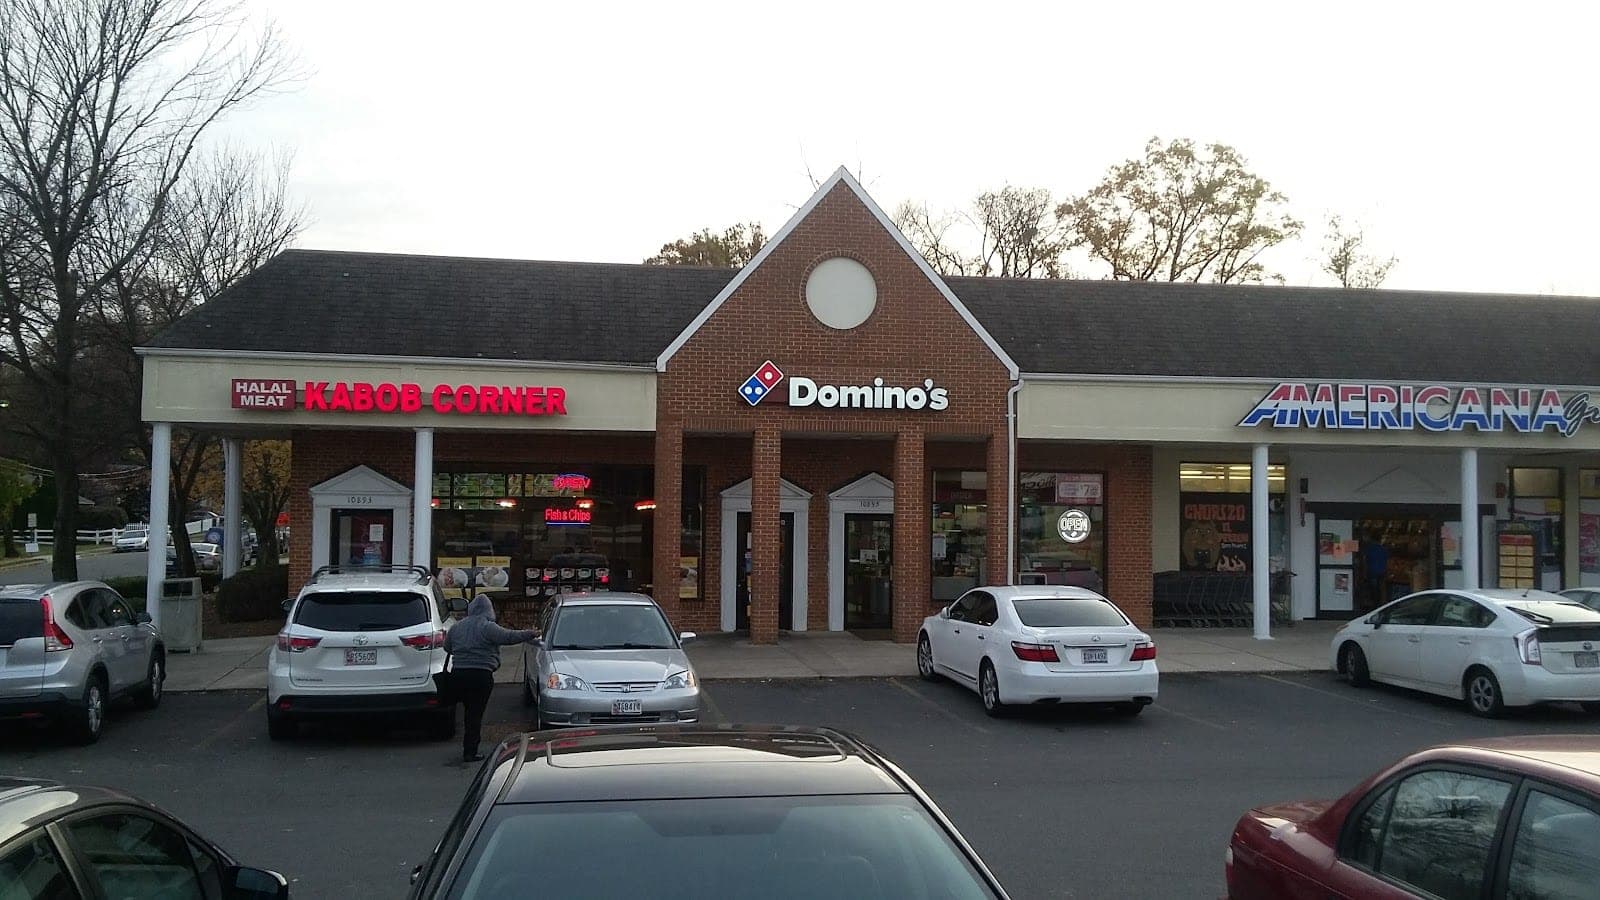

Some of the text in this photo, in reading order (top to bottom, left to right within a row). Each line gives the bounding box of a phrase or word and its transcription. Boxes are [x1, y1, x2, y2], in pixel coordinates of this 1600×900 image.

[235, 382, 292, 394] HALAL
[788, 376, 950, 411] Domino's
[239, 394, 288, 407] MEAT
[304, 380, 568, 416] KABOB CORNER
[1238, 383, 1568, 432] AMERICANA
[544, 508, 562, 521] Fish
[568, 508, 592, 523] Chips
[1060, 517, 1088, 532] OPEN
